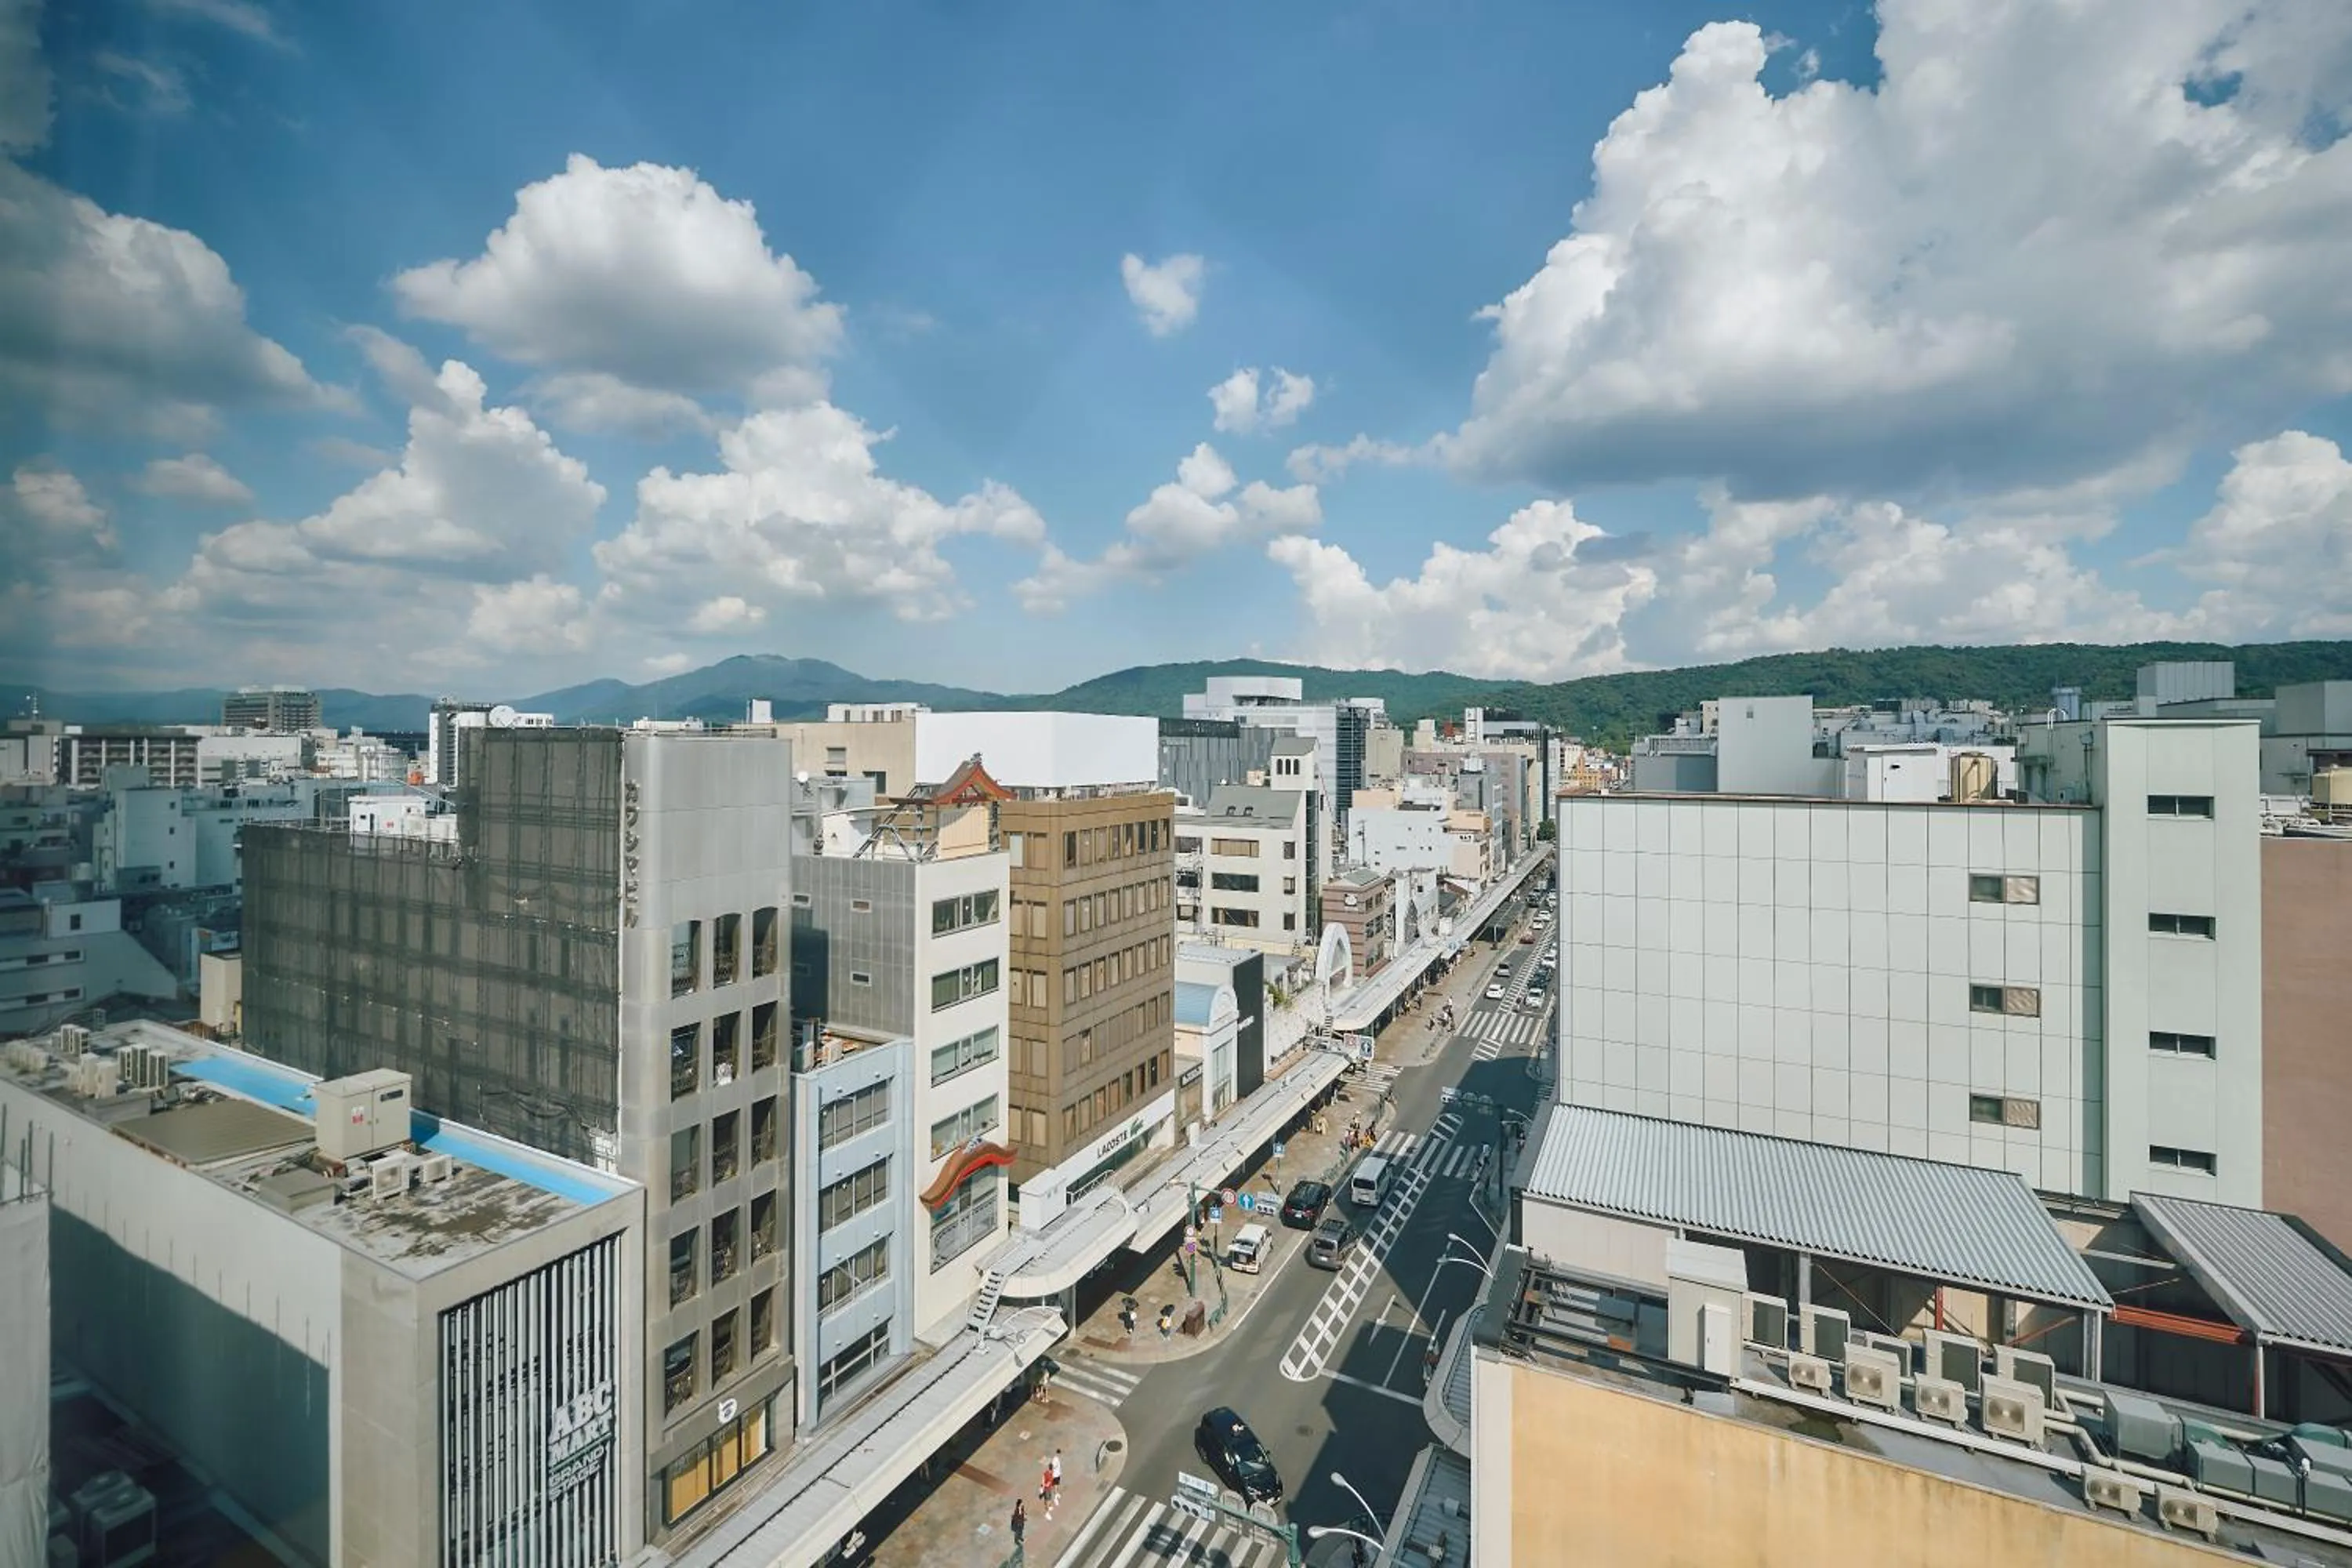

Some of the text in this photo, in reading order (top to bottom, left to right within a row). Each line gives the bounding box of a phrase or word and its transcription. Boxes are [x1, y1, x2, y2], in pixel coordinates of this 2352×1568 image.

[1098, 1130, 1128, 1158] LACOSTE
[549, 1380, 612, 1445] ABC
[549, 1409, 612, 1468] MART
[549, 1459, 601, 1501] STAGE
[550, 1446, 604, 1487] GRAND
